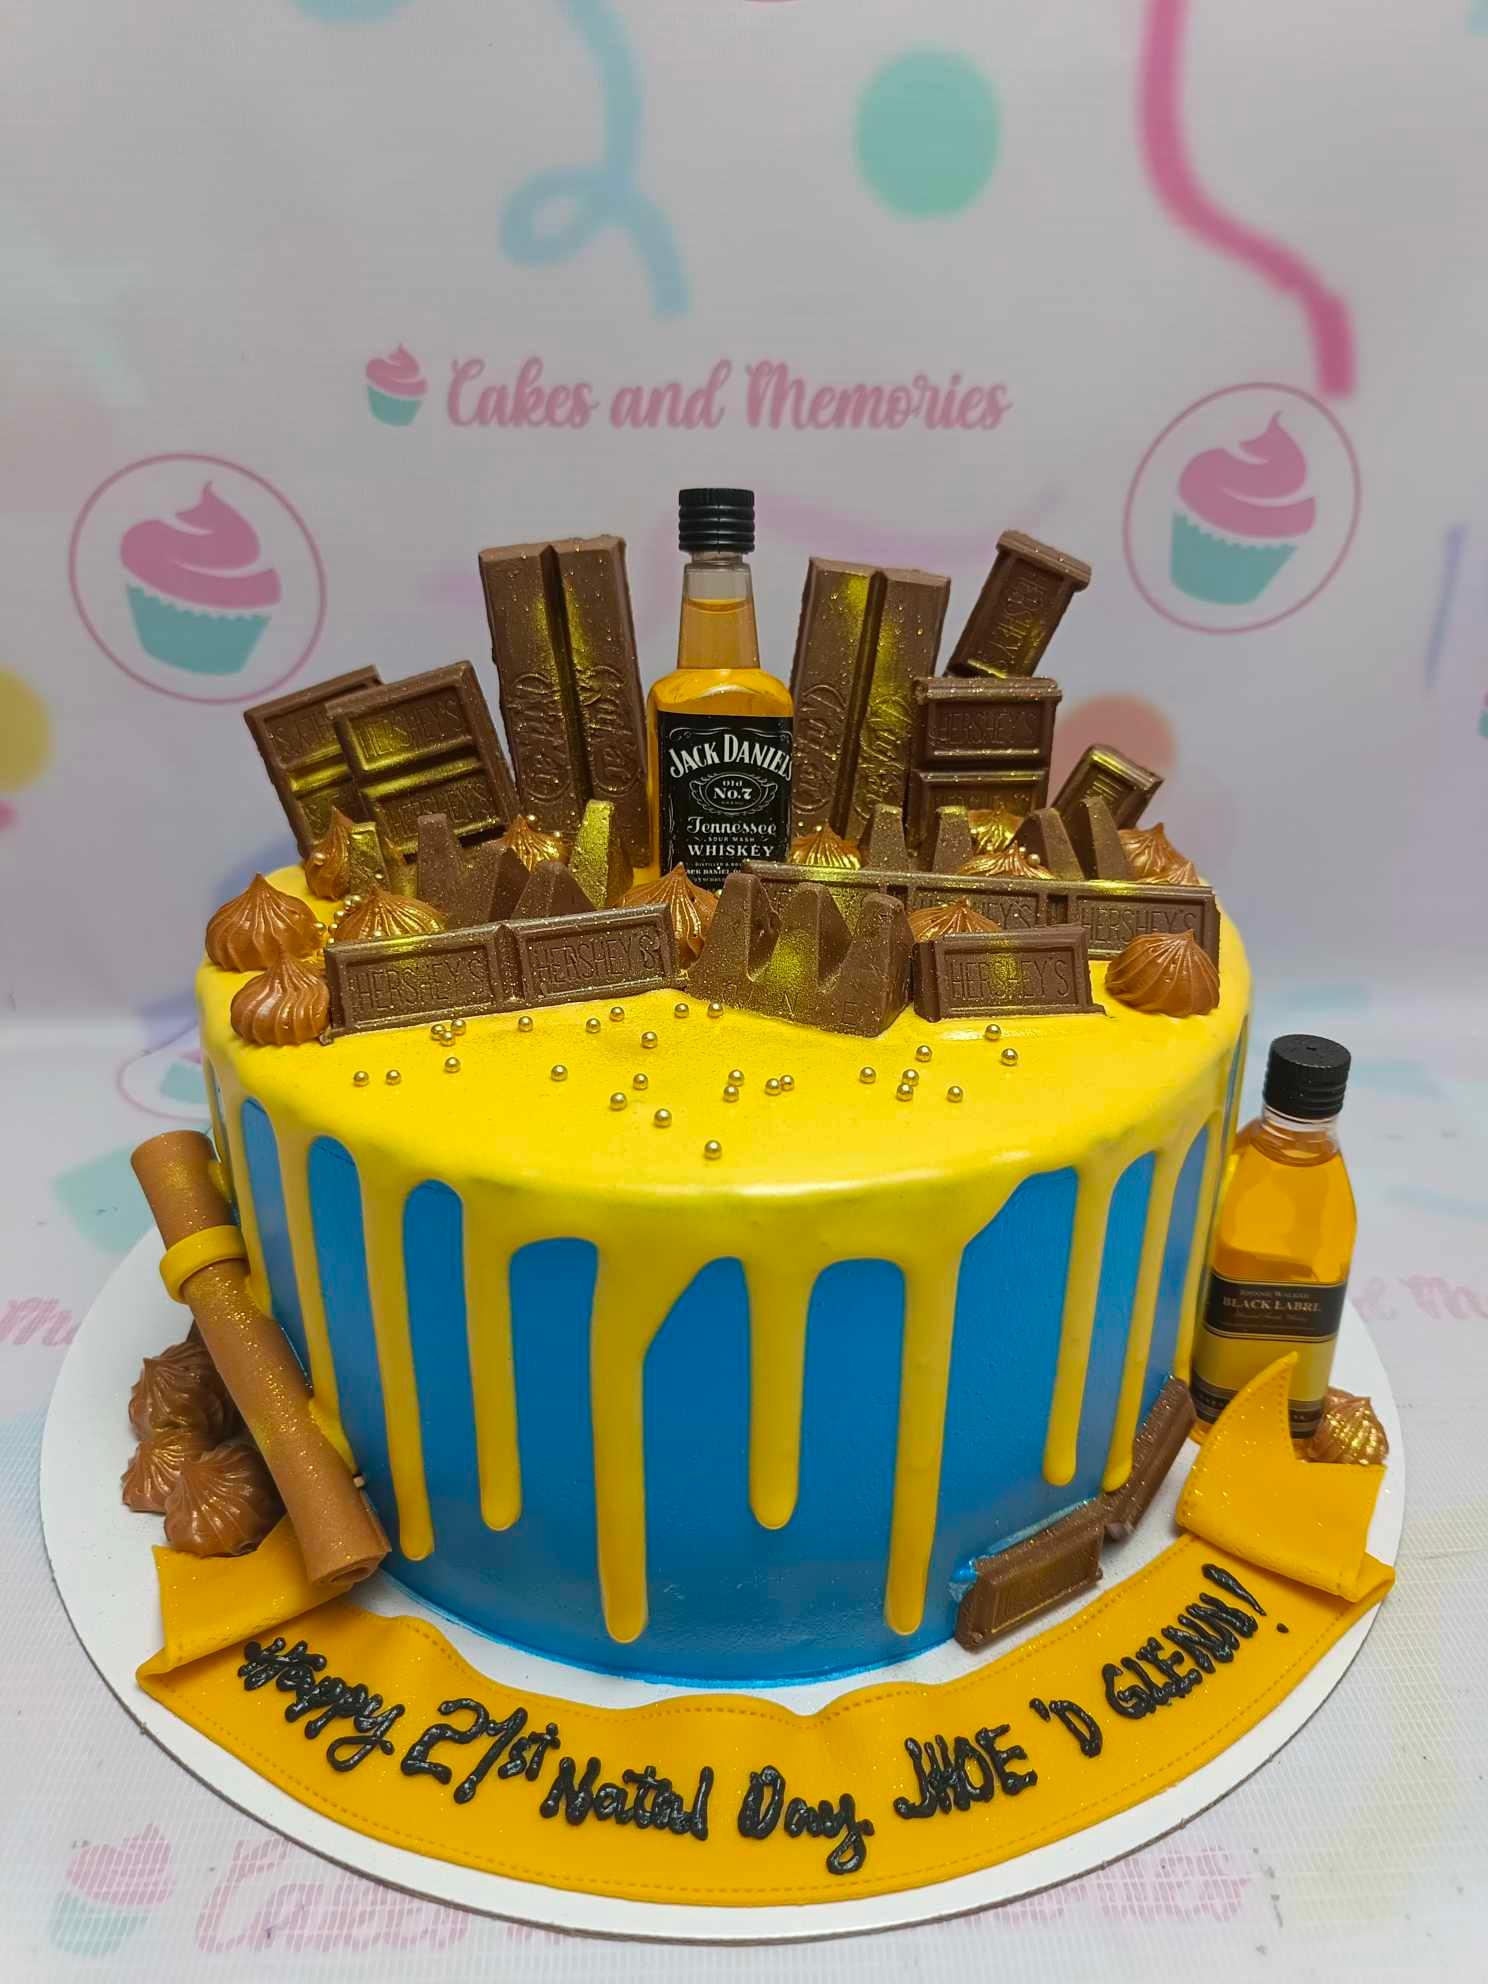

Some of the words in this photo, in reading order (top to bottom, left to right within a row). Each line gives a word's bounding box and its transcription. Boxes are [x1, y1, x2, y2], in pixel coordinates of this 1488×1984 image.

[446, 356, 600, 429] Cakes
[609, 358, 733, 430] and
[744, 359, 1013, 430] Memories
[669, 741, 720, 778] JACK
[713, 787, 752, 800] No.7
[687, 816, 777, 835] Tennessee
[688, 844, 774, 857] WHISKEY
[950, 955, 1068, 1001] HERSHEY'S
[1223, 1297, 1270, 1310] BLACK
[540, 1756, 714, 1841] Natal
[737, 1765, 875, 1875] Day
